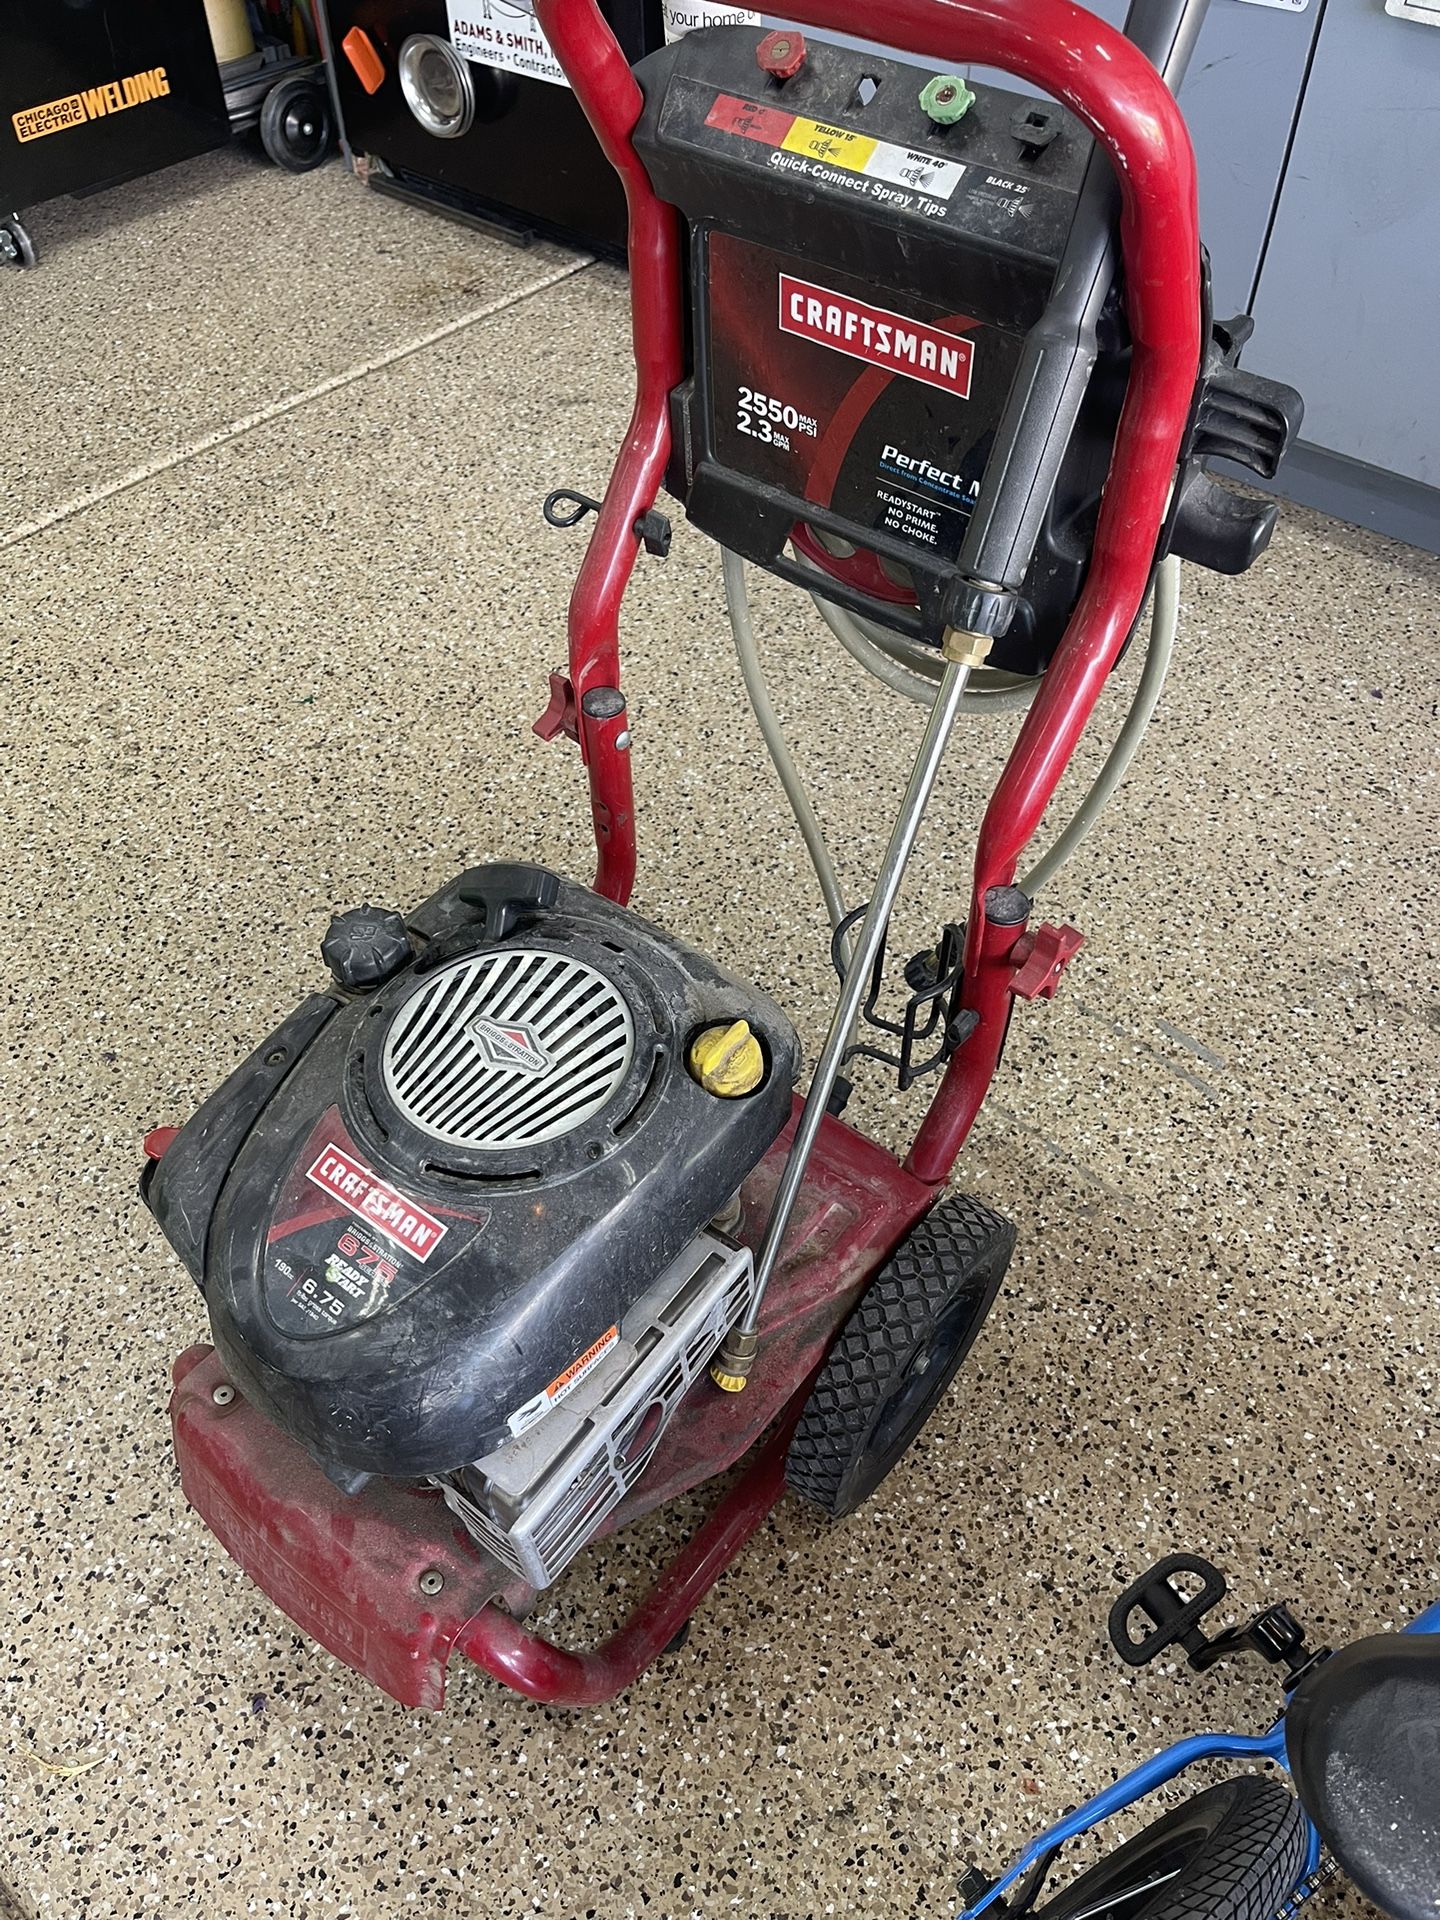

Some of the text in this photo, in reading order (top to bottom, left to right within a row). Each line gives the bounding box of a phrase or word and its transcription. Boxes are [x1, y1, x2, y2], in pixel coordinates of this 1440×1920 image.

[670, 9, 699, 27] your
[703, 12, 745, 28] home
[454, 20, 492, 42] ADAMS
[495, 30, 503, 45] &
[507, 33, 547, 59] SMITH,
[455, 38, 504, 62] Engineers
[513, 53, 565, 79] Contracto
[81, 67, 170, 120] WELDING
[742, 103, 758, 113] RED
[17, 102, 69, 126] CHICAGO
[20, 110, 82, 138] ELECTRIC
[814, 124, 845, 138] YELLOW
[906, 152, 932, 165] WHITE
[770, 151, 869, 192] Quick-Connect
[871, 183, 911, 210] Spray
[916, 193, 947, 217] Tips
[985, 175, 1014, 191] BLACK
[738, 386, 817, 430] 2550 MAX
[737, 410, 789, 443] 2.3 MAX
[798, 423, 817, 438] PSI
[773, 438, 790, 451] GPM
[879, 461, 901, 475] Direct
[901, 470, 918, 482] from
[918, 476, 961, 499] Concentrate
[881, 444, 963, 490] Perfect
[884, 517, 938, 545] NO CHOKE.
[888, 506, 939, 534] NO PRIME.
[324, 1253, 369, 1286] READY
[338, 1233, 398, 1284] 675
[302, 1278, 345, 1316] 6.75
[327, 1267, 366, 1298] START
[321, 1310, 337, 1325] torque
[554, 1341, 615, 1402] HOT SURFACES
[565, 1332, 612, 1379] WARNING
